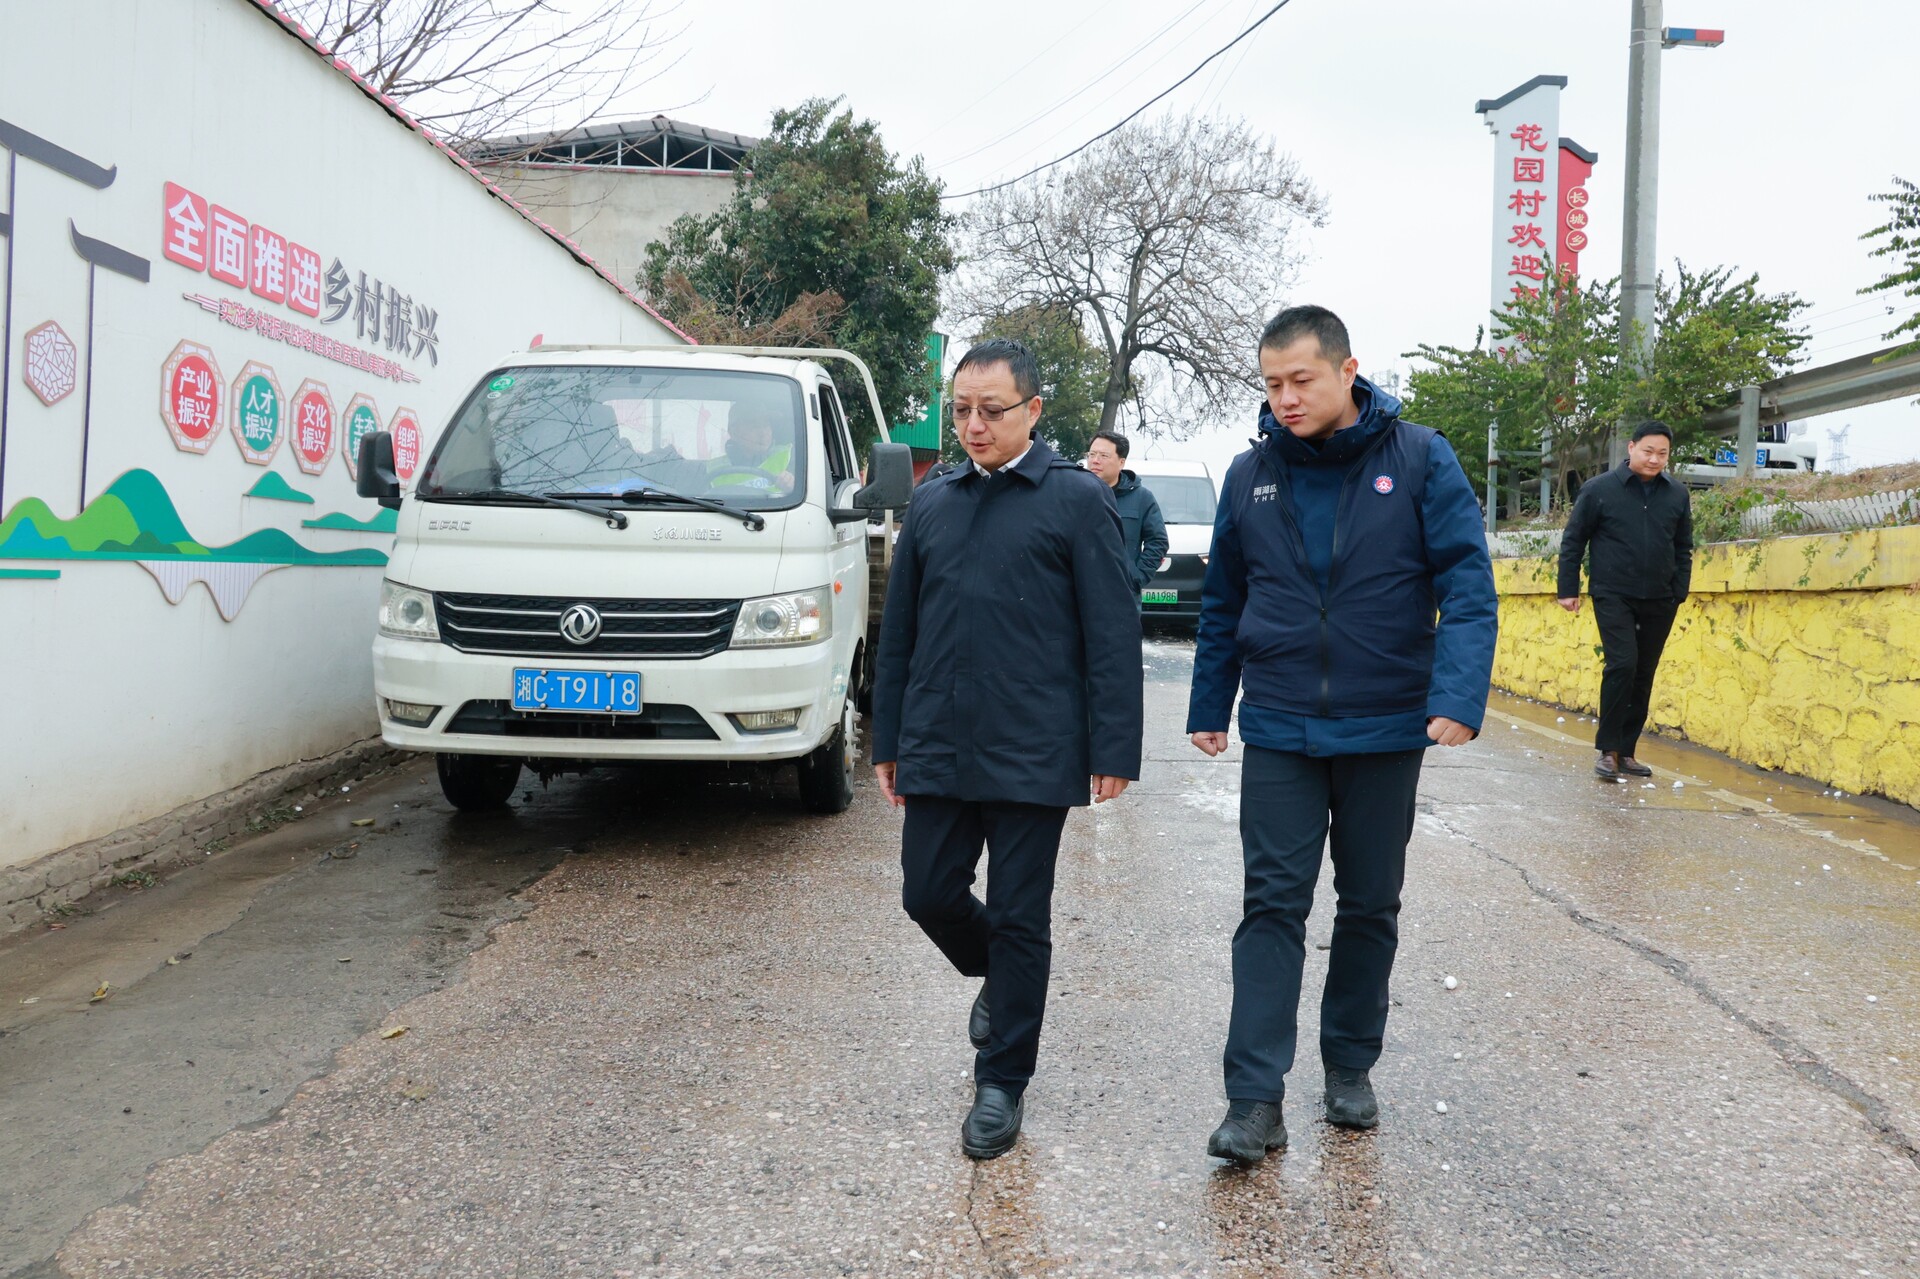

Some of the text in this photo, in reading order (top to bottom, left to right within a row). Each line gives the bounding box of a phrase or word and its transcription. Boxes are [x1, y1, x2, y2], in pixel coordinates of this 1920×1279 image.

[1567, 191, 1588, 246] 长城乡
[179, 366, 211, 399] 产业
[178, 395, 211, 429] 振兴
[246, 385, 274, 414] 人才
[245, 412, 273, 442] 振兴
[303, 401, 327, 429] 文化
[302, 426, 326, 454] 振兴
[398, 426, 416, 449] 组织
[397, 447, 415, 471] 振兴
